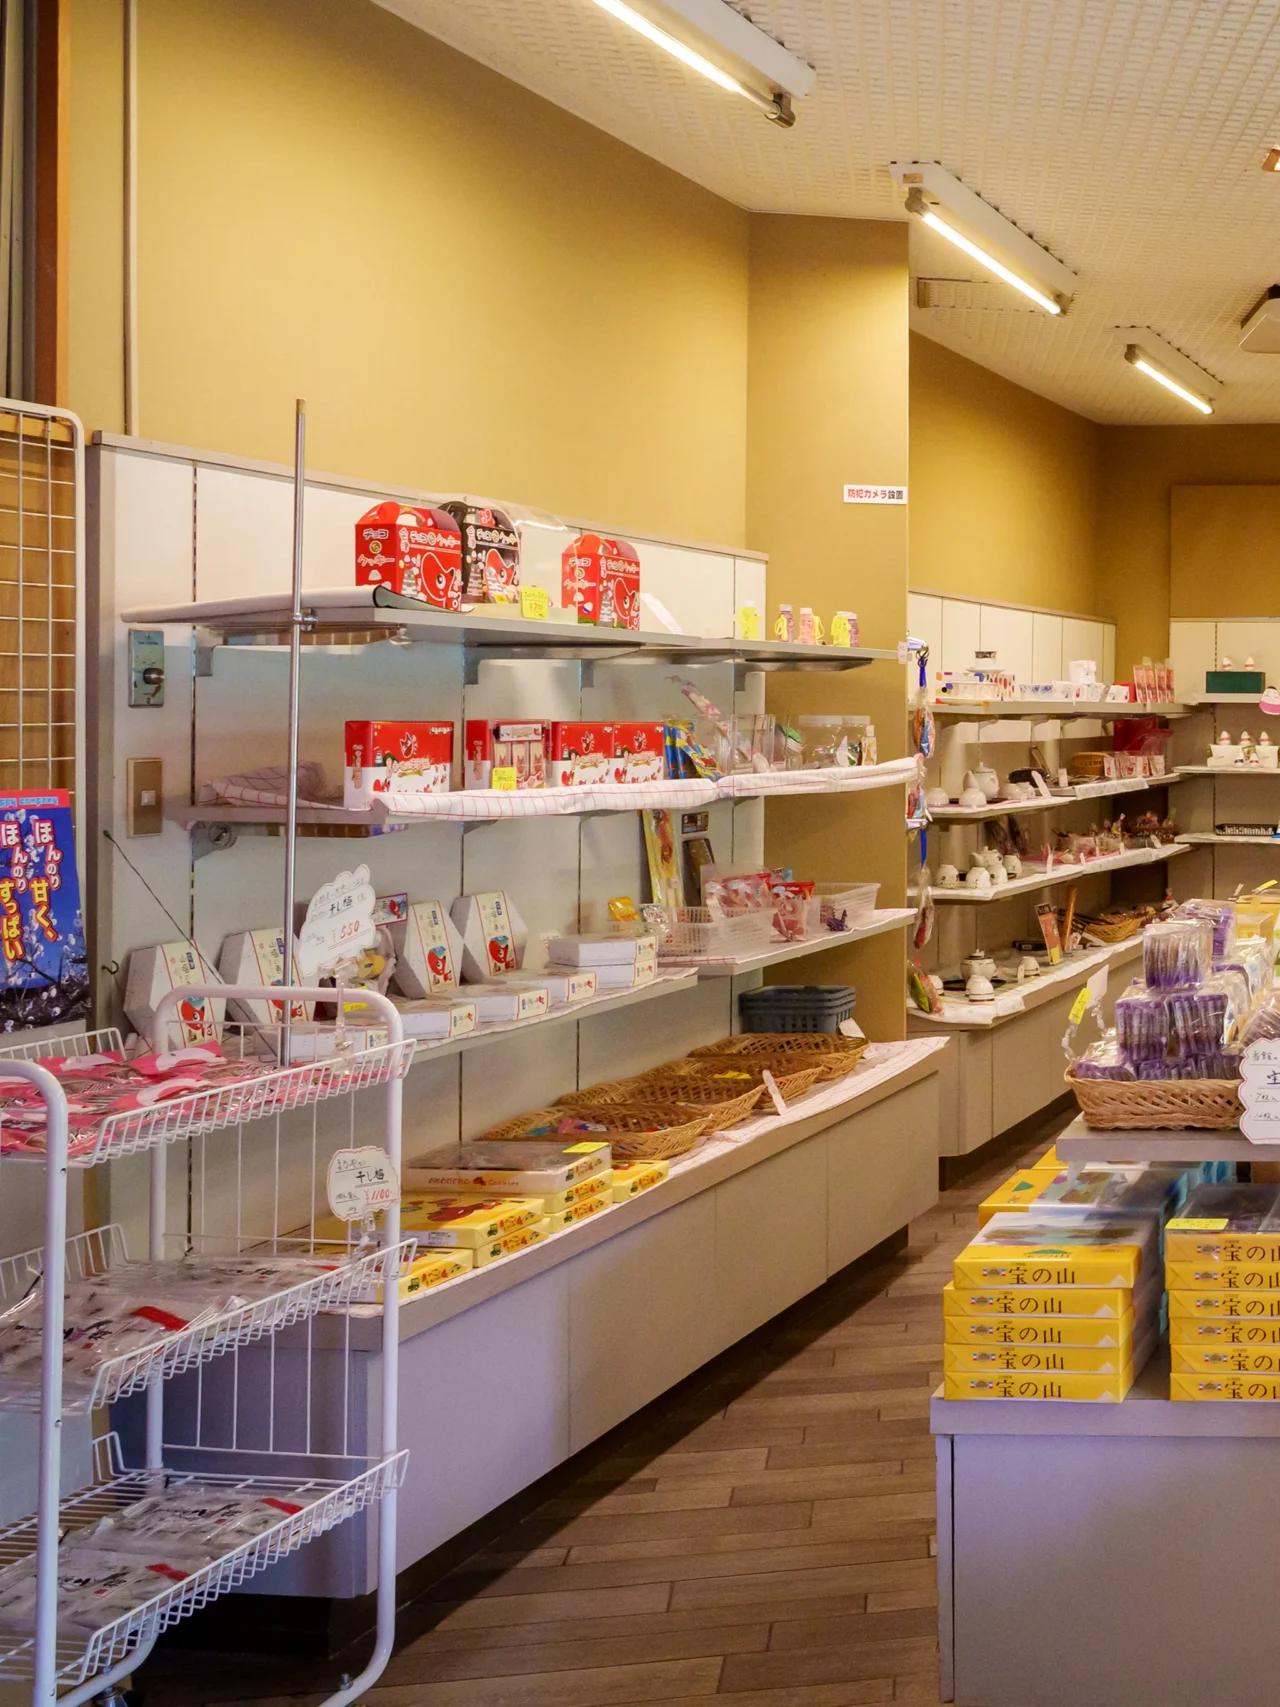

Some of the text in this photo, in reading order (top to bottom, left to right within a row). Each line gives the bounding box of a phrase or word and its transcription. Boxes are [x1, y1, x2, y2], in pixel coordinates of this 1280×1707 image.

[847, 488, 904, 500] 防犯カメラ設置
[1008, 1266, 1075, 1285] 宝の山
[996, 1295, 1062, 1314] 宝の山
[996, 1324, 1061, 1343] 宝の山
[998, 1351, 1064, 1370] 宝の山
[996, 1379, 1062, 1399] 宝の山
